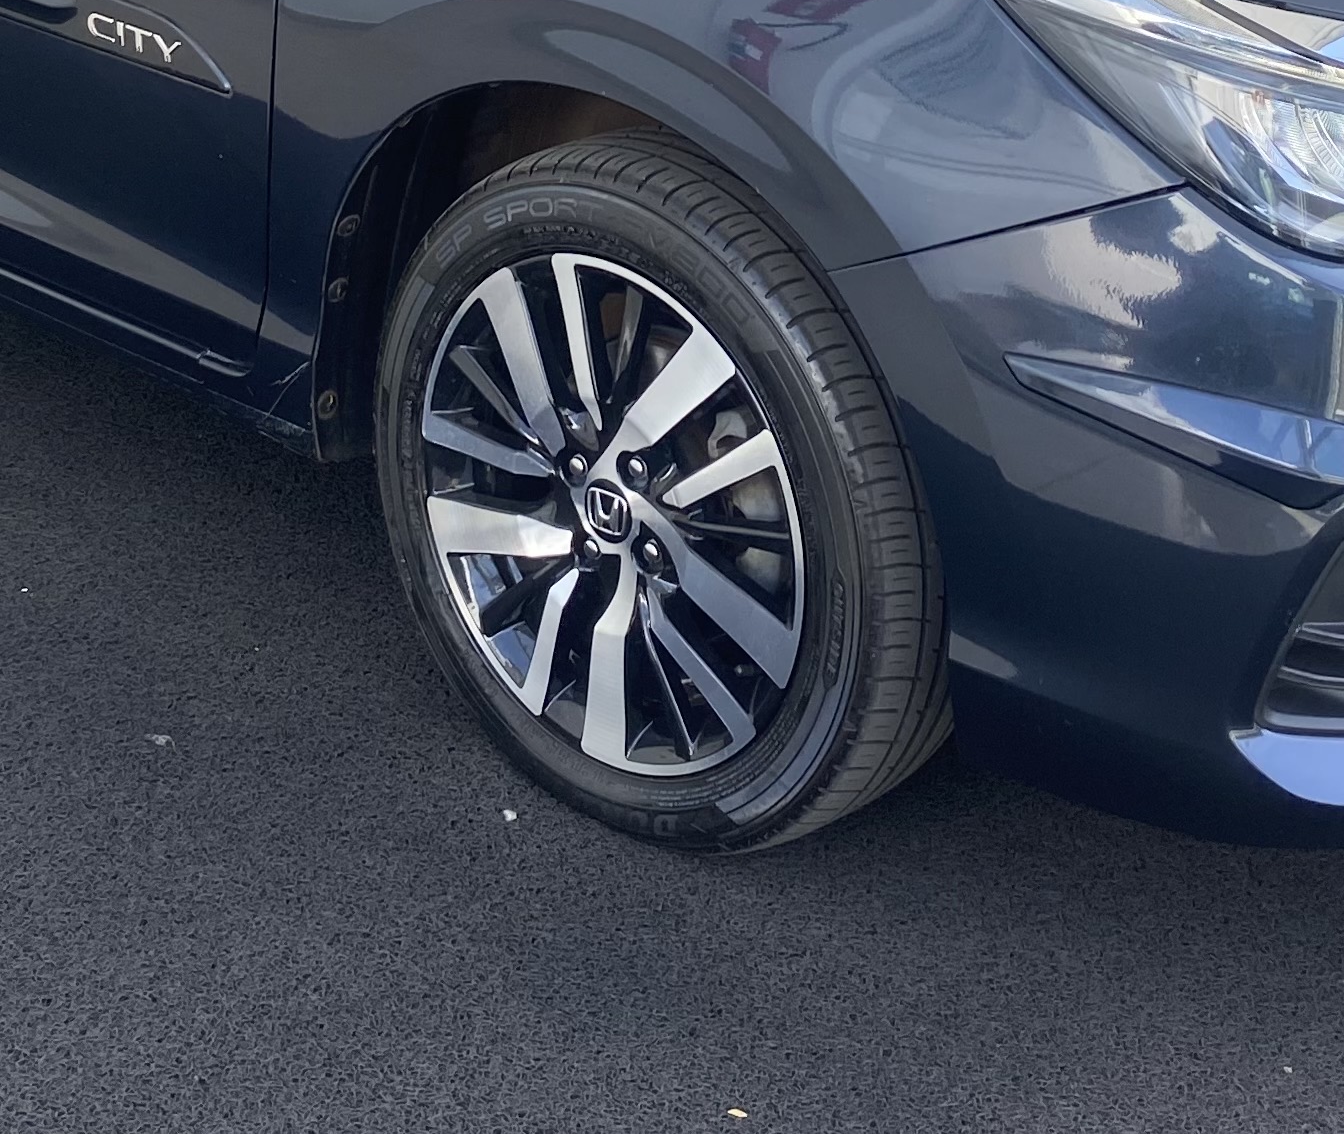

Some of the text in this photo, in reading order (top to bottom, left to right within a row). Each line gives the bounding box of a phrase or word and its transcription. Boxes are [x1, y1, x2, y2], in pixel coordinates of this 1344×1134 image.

[87, 12, 182, 63] CITY
[436, 224, 472, 263] SP
[484, 197, 604, 231] SPORT
